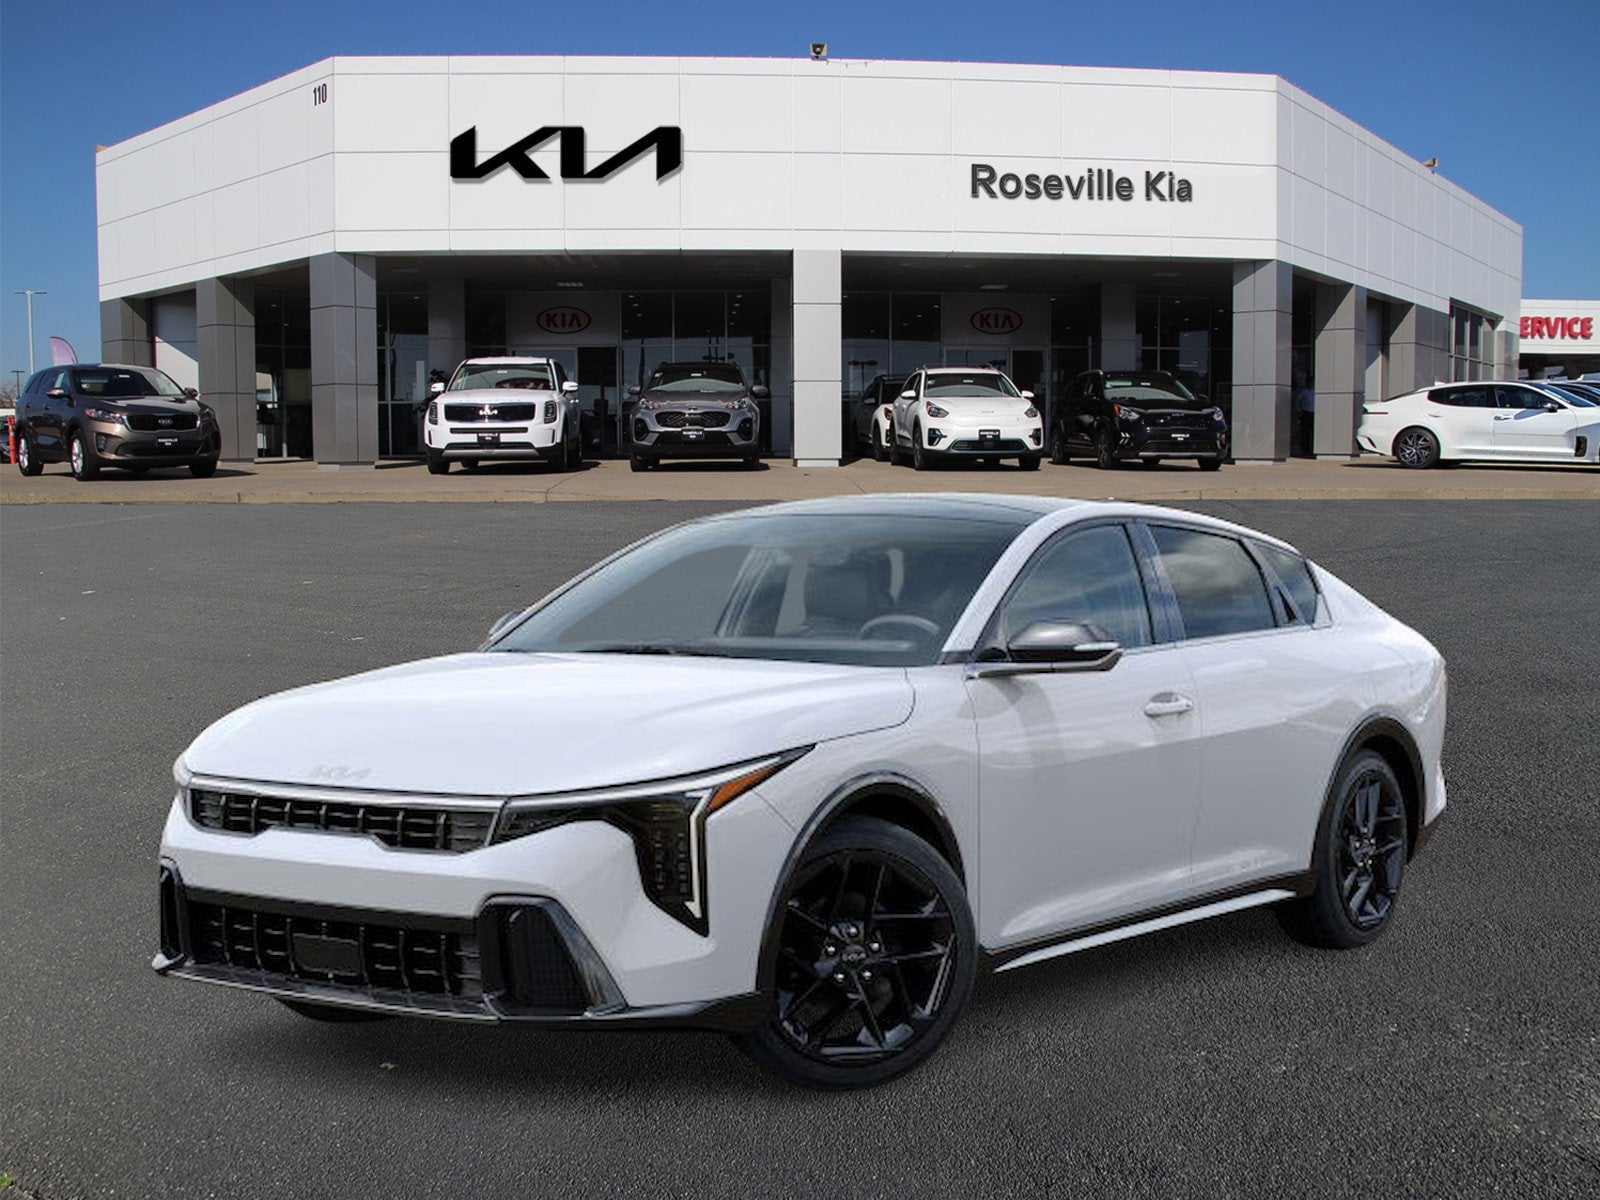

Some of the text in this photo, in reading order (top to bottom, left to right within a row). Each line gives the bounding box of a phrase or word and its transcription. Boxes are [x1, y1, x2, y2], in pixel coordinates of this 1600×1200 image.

[313, 83, 328, 106] 110
[450, 125, 683, 182] KIA
[971, 163, 1193, 202] Roseville Kia
[546, 313, 582, 328] KIA
[980, 313, 1014, 328] KIA
[1520, 316, 1593, 338] ERVICE
